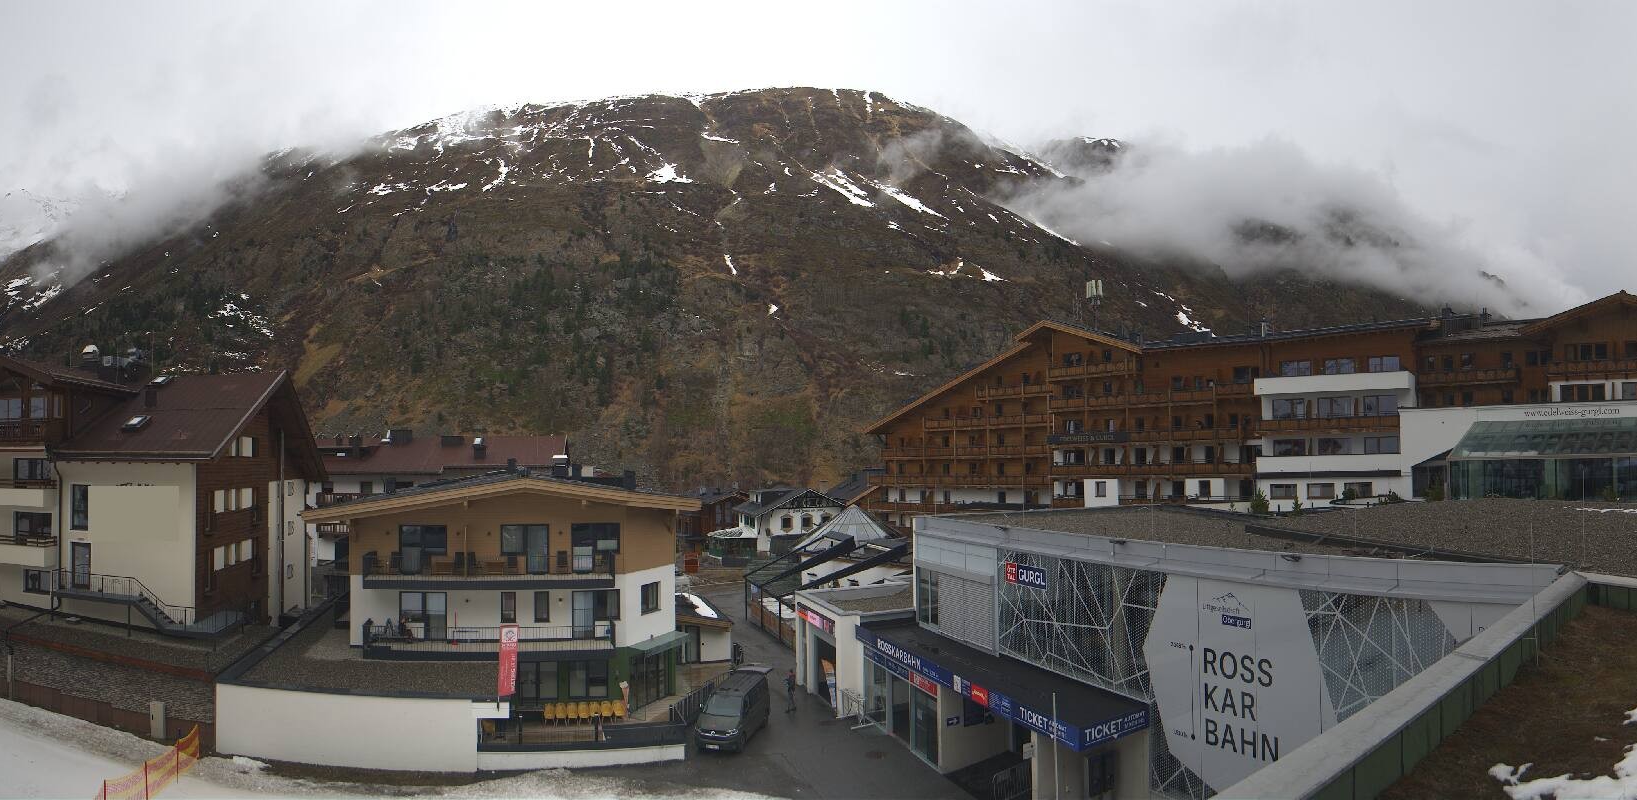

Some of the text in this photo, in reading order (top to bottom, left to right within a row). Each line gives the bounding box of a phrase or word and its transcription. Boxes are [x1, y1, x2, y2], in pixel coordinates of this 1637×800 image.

[1018, 569, 1045, 585] GURGL
[877, 638, 922, 671] ROSSKARBAHN
[1203, 647, 1273, 688] ROSS
[1019, 706, 1049, 730] TICKET
[1204, 682, 1256, 722] KAR
[1084, 718, 1123, 742] TICKET
[1205, 718, 1279, 762] BAHN
